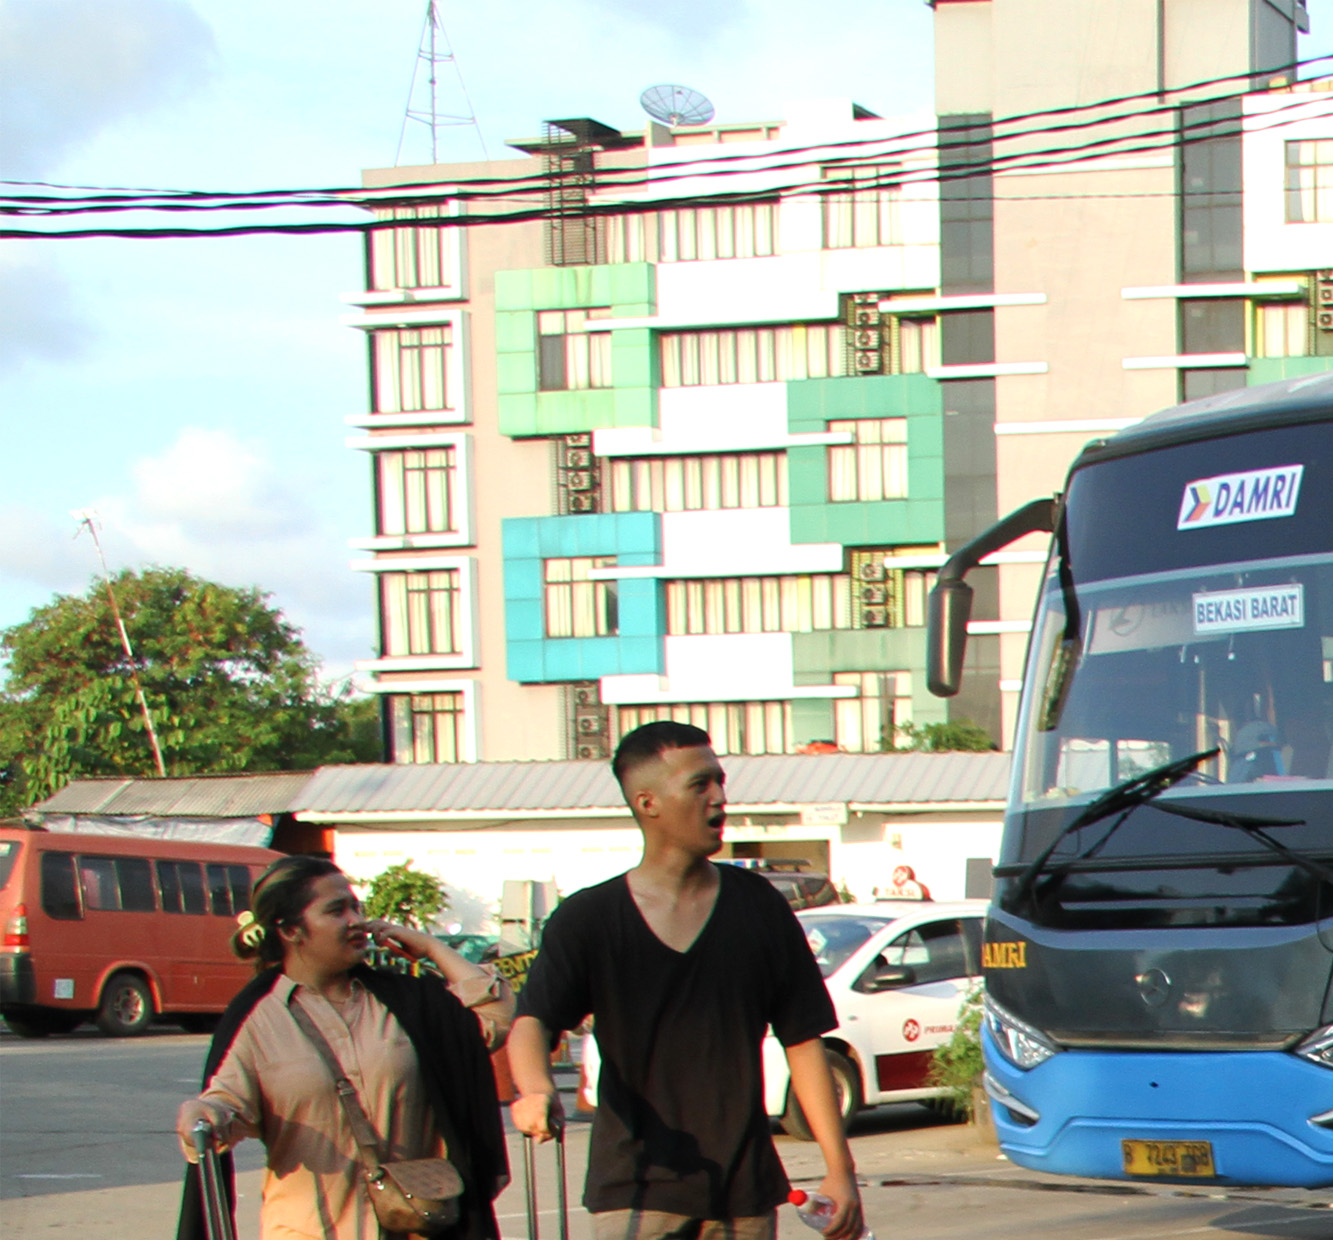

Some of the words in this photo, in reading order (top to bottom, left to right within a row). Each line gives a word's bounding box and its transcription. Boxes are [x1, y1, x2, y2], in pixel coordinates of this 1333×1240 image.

[1213, 472, 1296, 518] DAMRI
[1197, 600, 1247, 624] BEKASI
[1250, 595, 1297, 619] BARAT
[981, 941, 1027, 969] AMRI
